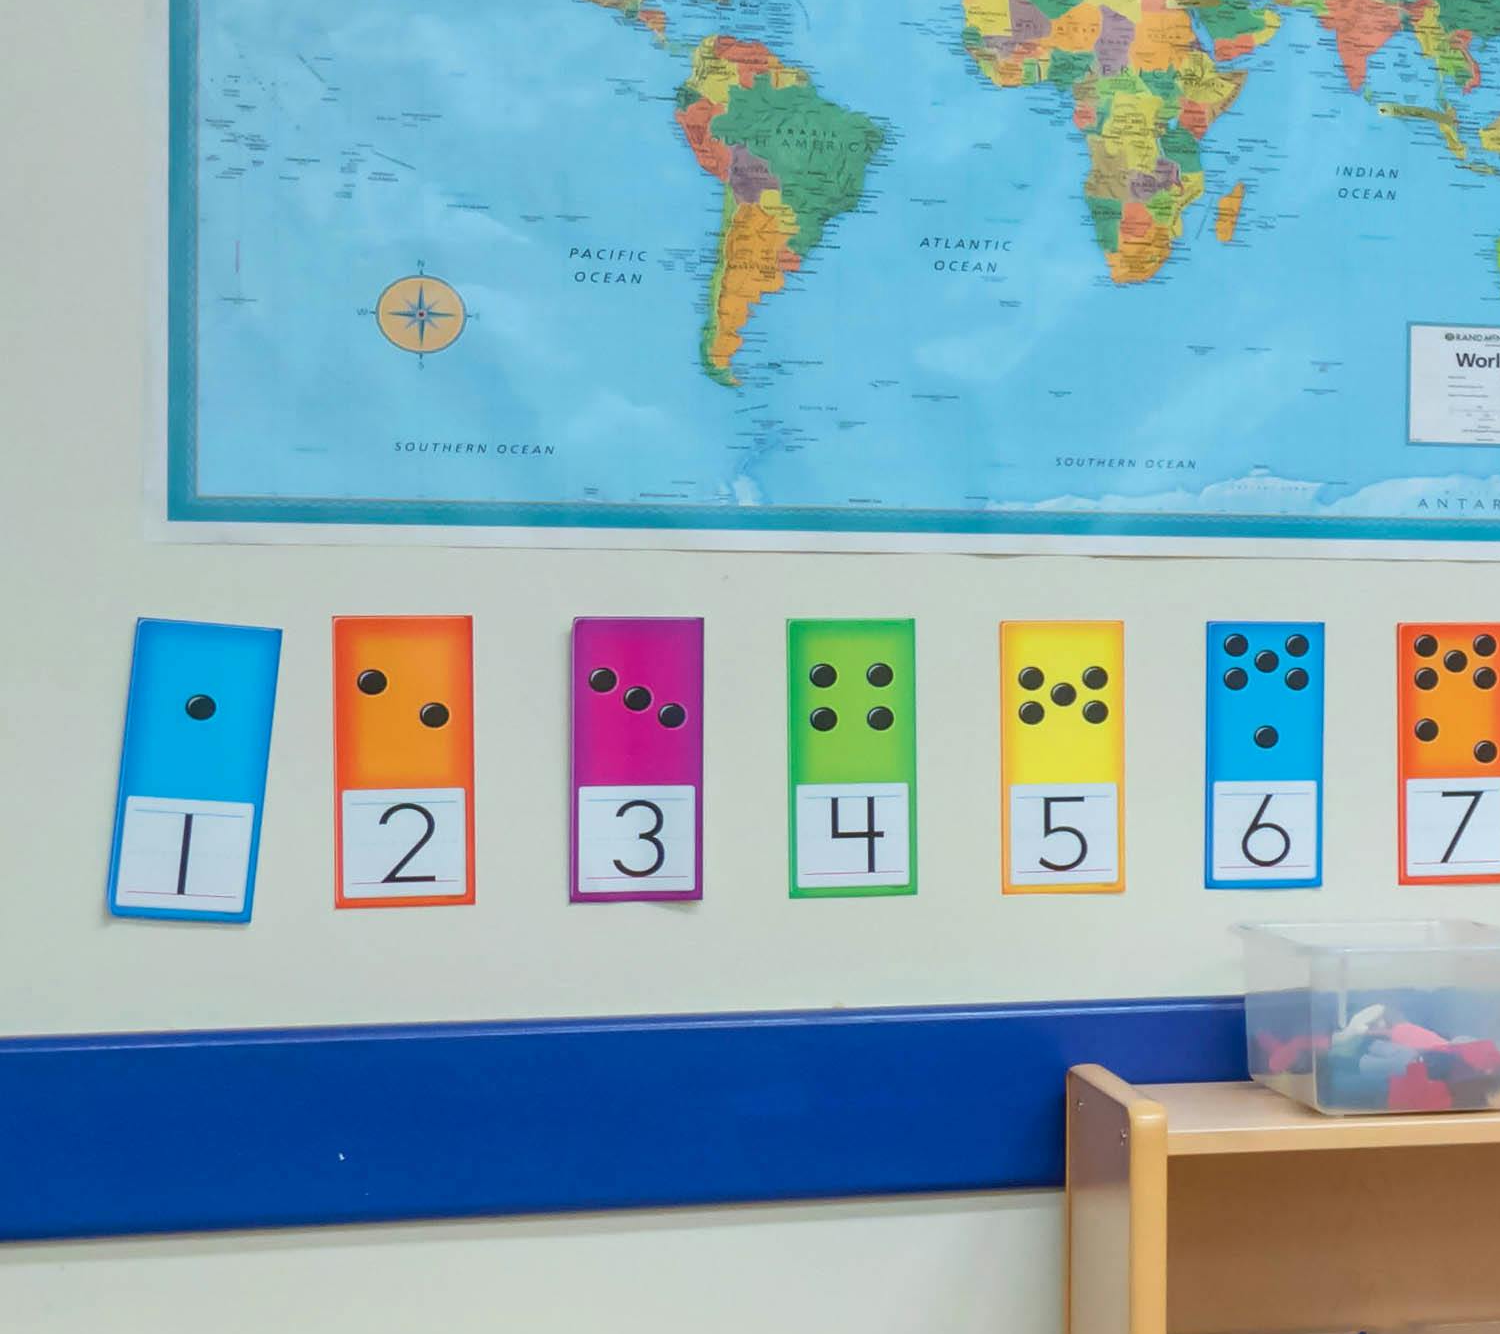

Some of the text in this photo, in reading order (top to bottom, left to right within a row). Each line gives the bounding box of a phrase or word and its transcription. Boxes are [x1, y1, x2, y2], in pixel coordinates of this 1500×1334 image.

[781, 138, 874, 154] AMERICA
[1336, 166, 1399, 180] INDIAN
[1338, 187, 1397, 201] OCEAN
[920, 237, 1013, 252] ATLANTIC
[569, 247, 648, 262] PACIFIC
[934, 260, 997, 273] OCEAN
[574, 271, 643, 285] OCEAN
[1456, 333, 1483, 342] RAND
[394, 441, 555, 455] SOUTHERN OCEAN
[1055, 456, 1197, 470] SOUTHERN OCEAN
[830, 796, 885, 874] 4
[1037, 795, 1089, 872] 5
[1241, 793, 1292, 867] 6
[1440, 791, 1485, 865] 7
[378, 802, 436, 884] 2
[612, 799, 666, 879] 3
[172, 812, 193, 896] 1
